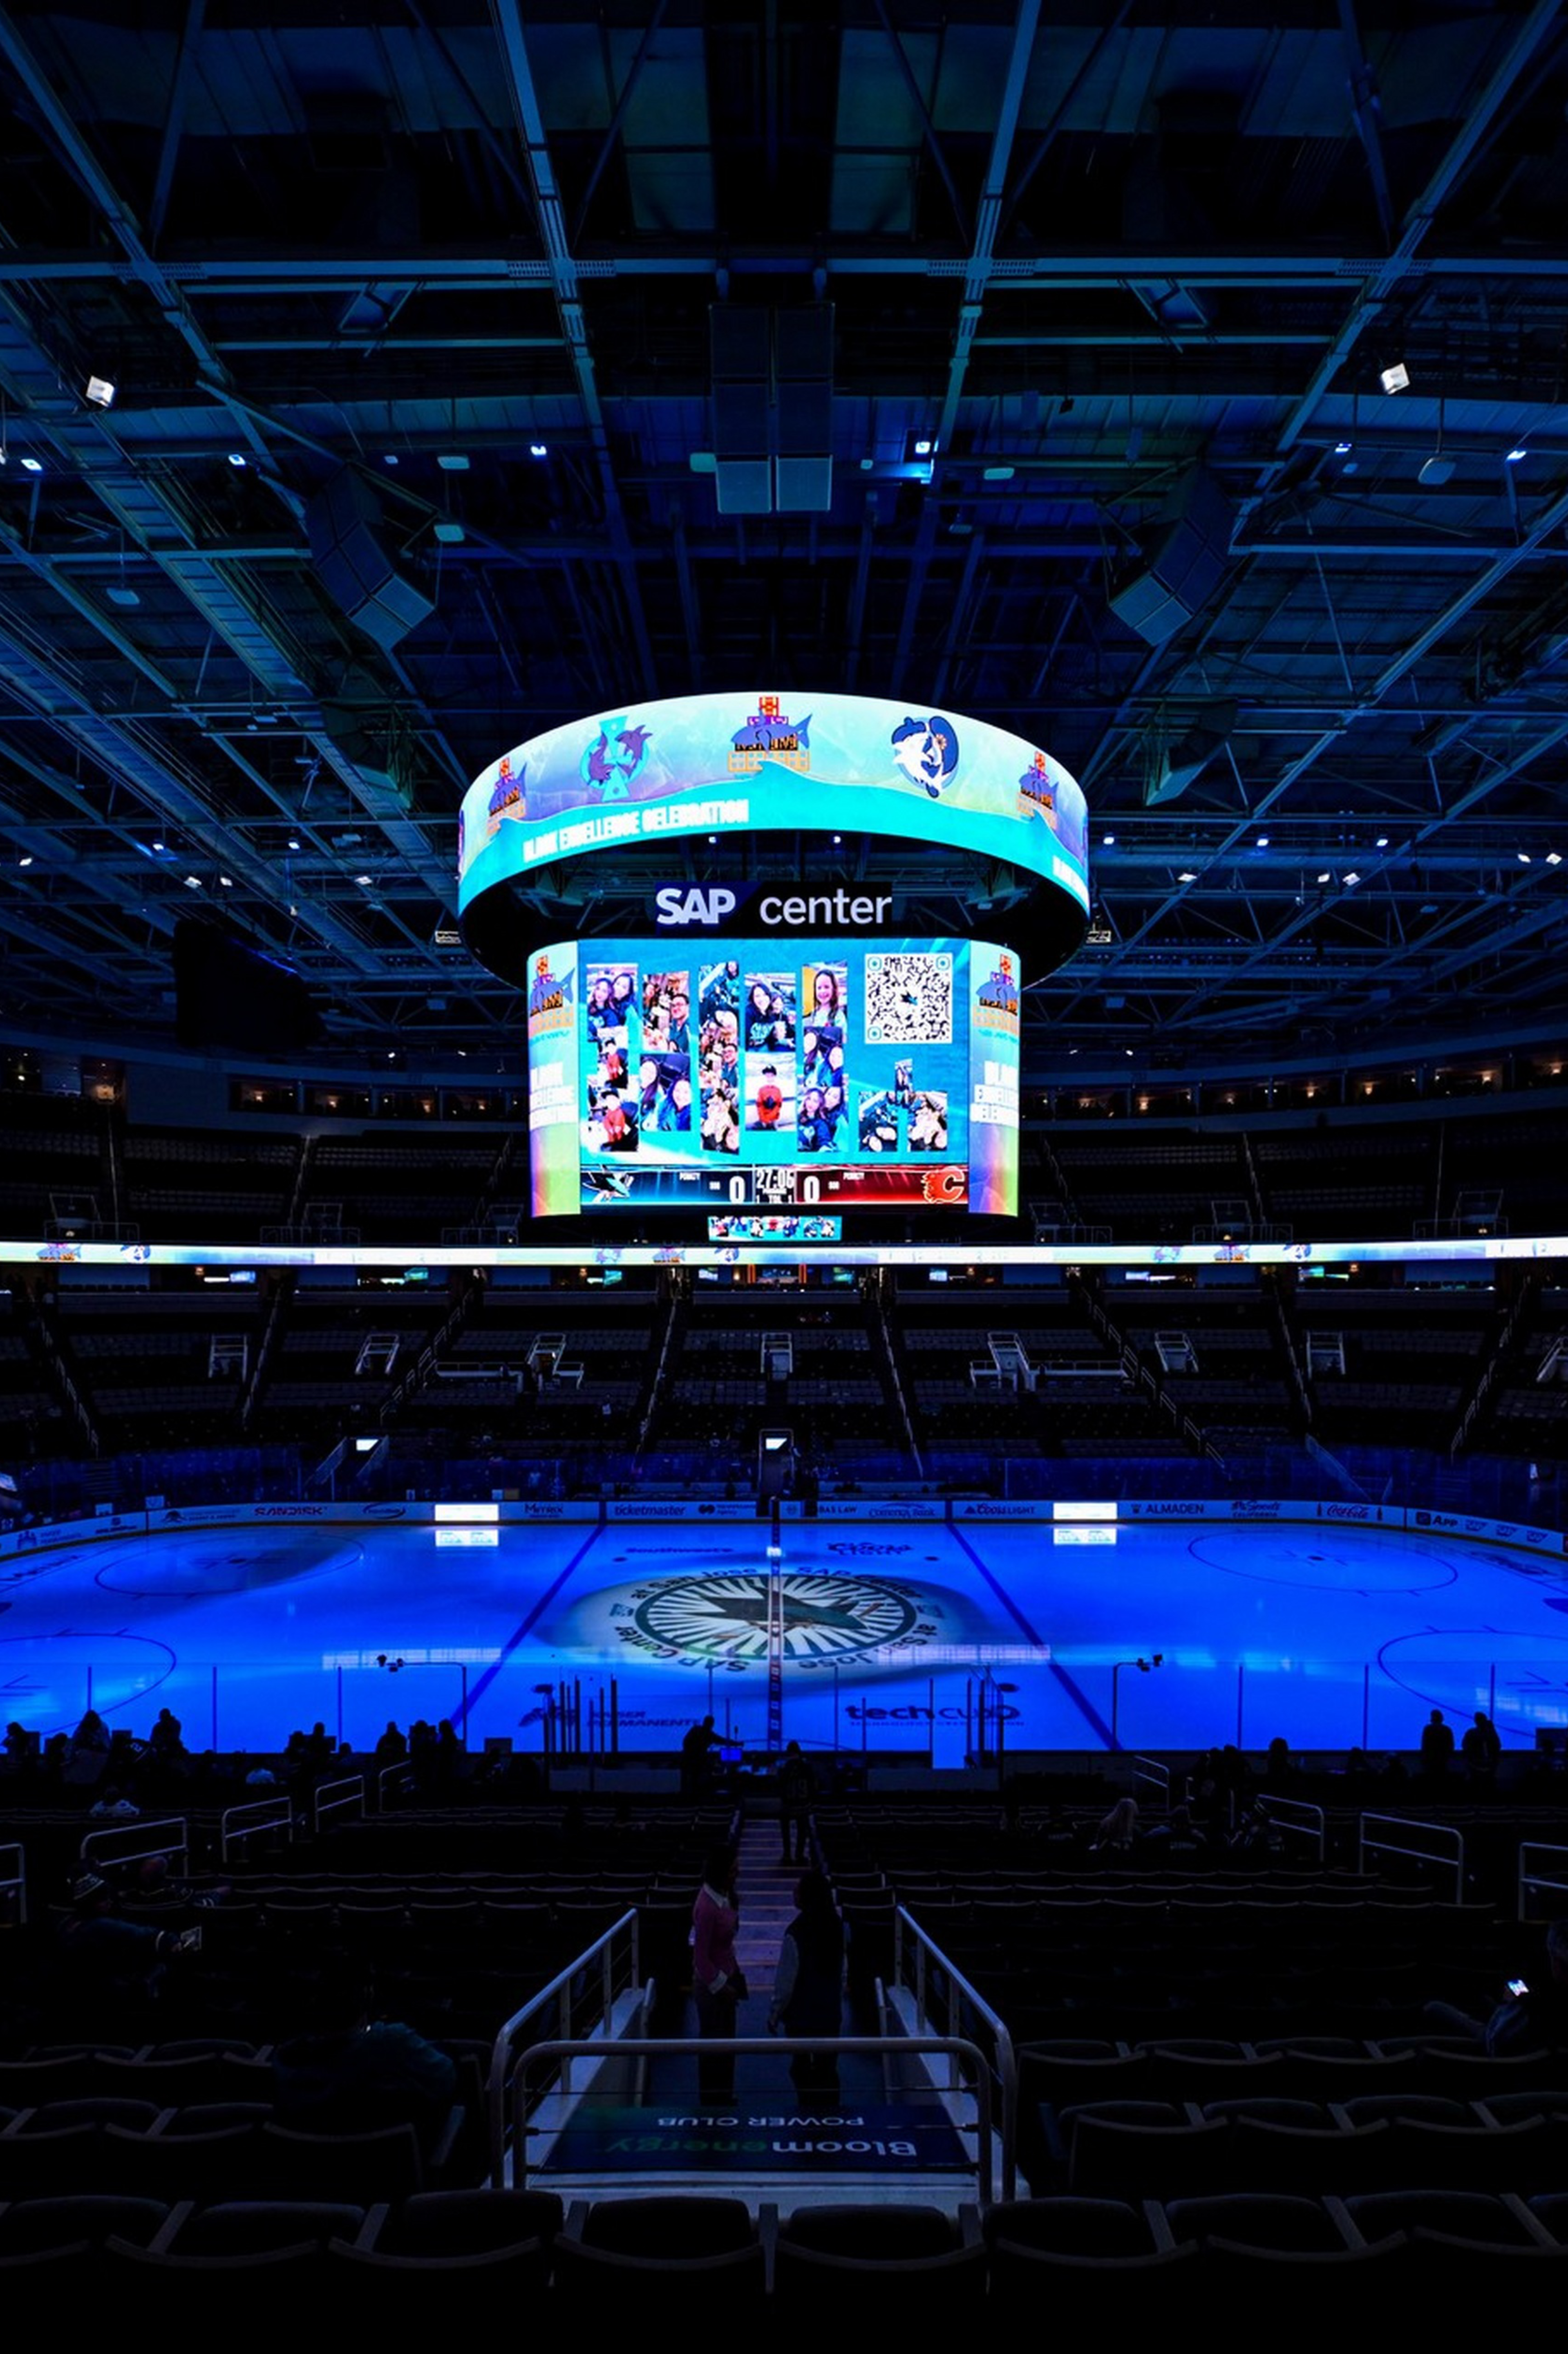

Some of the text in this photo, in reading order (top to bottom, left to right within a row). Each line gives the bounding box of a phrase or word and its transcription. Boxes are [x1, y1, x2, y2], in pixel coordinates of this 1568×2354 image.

[656, 888, 892, 924] SAP center
[729, 1176, 746, 1204] 0
[803, 1176, 820, 1204] 0
[615, 1505, 686, 1515] ticketmaster
[1146, 1504, 1204, 1514] ALMADEN
[658, 2117, 864, 2126] POWER CLUB
